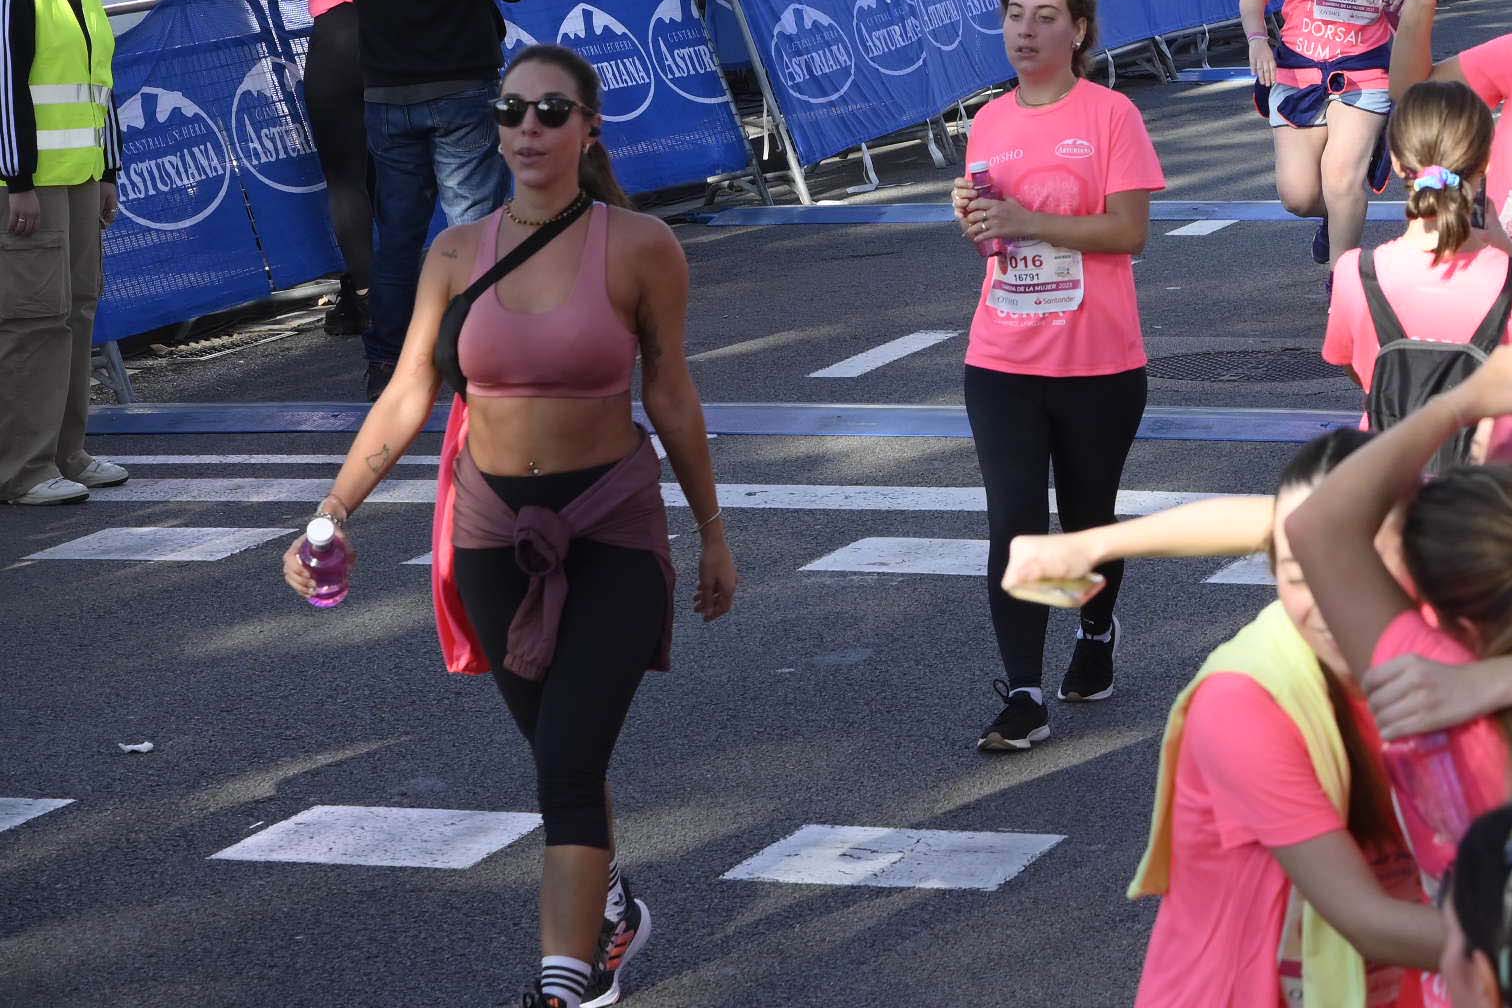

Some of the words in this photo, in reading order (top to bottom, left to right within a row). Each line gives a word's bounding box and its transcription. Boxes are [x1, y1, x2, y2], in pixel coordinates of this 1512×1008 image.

[989, 149, 1024, 167] OYSHO
[1010, 254, 1044, 269] 016
[1013, 273, 1040, 282] 16791
[1035, 283, 1057, 291] MUJER
[1043, 294, 1076, 305] Santander
